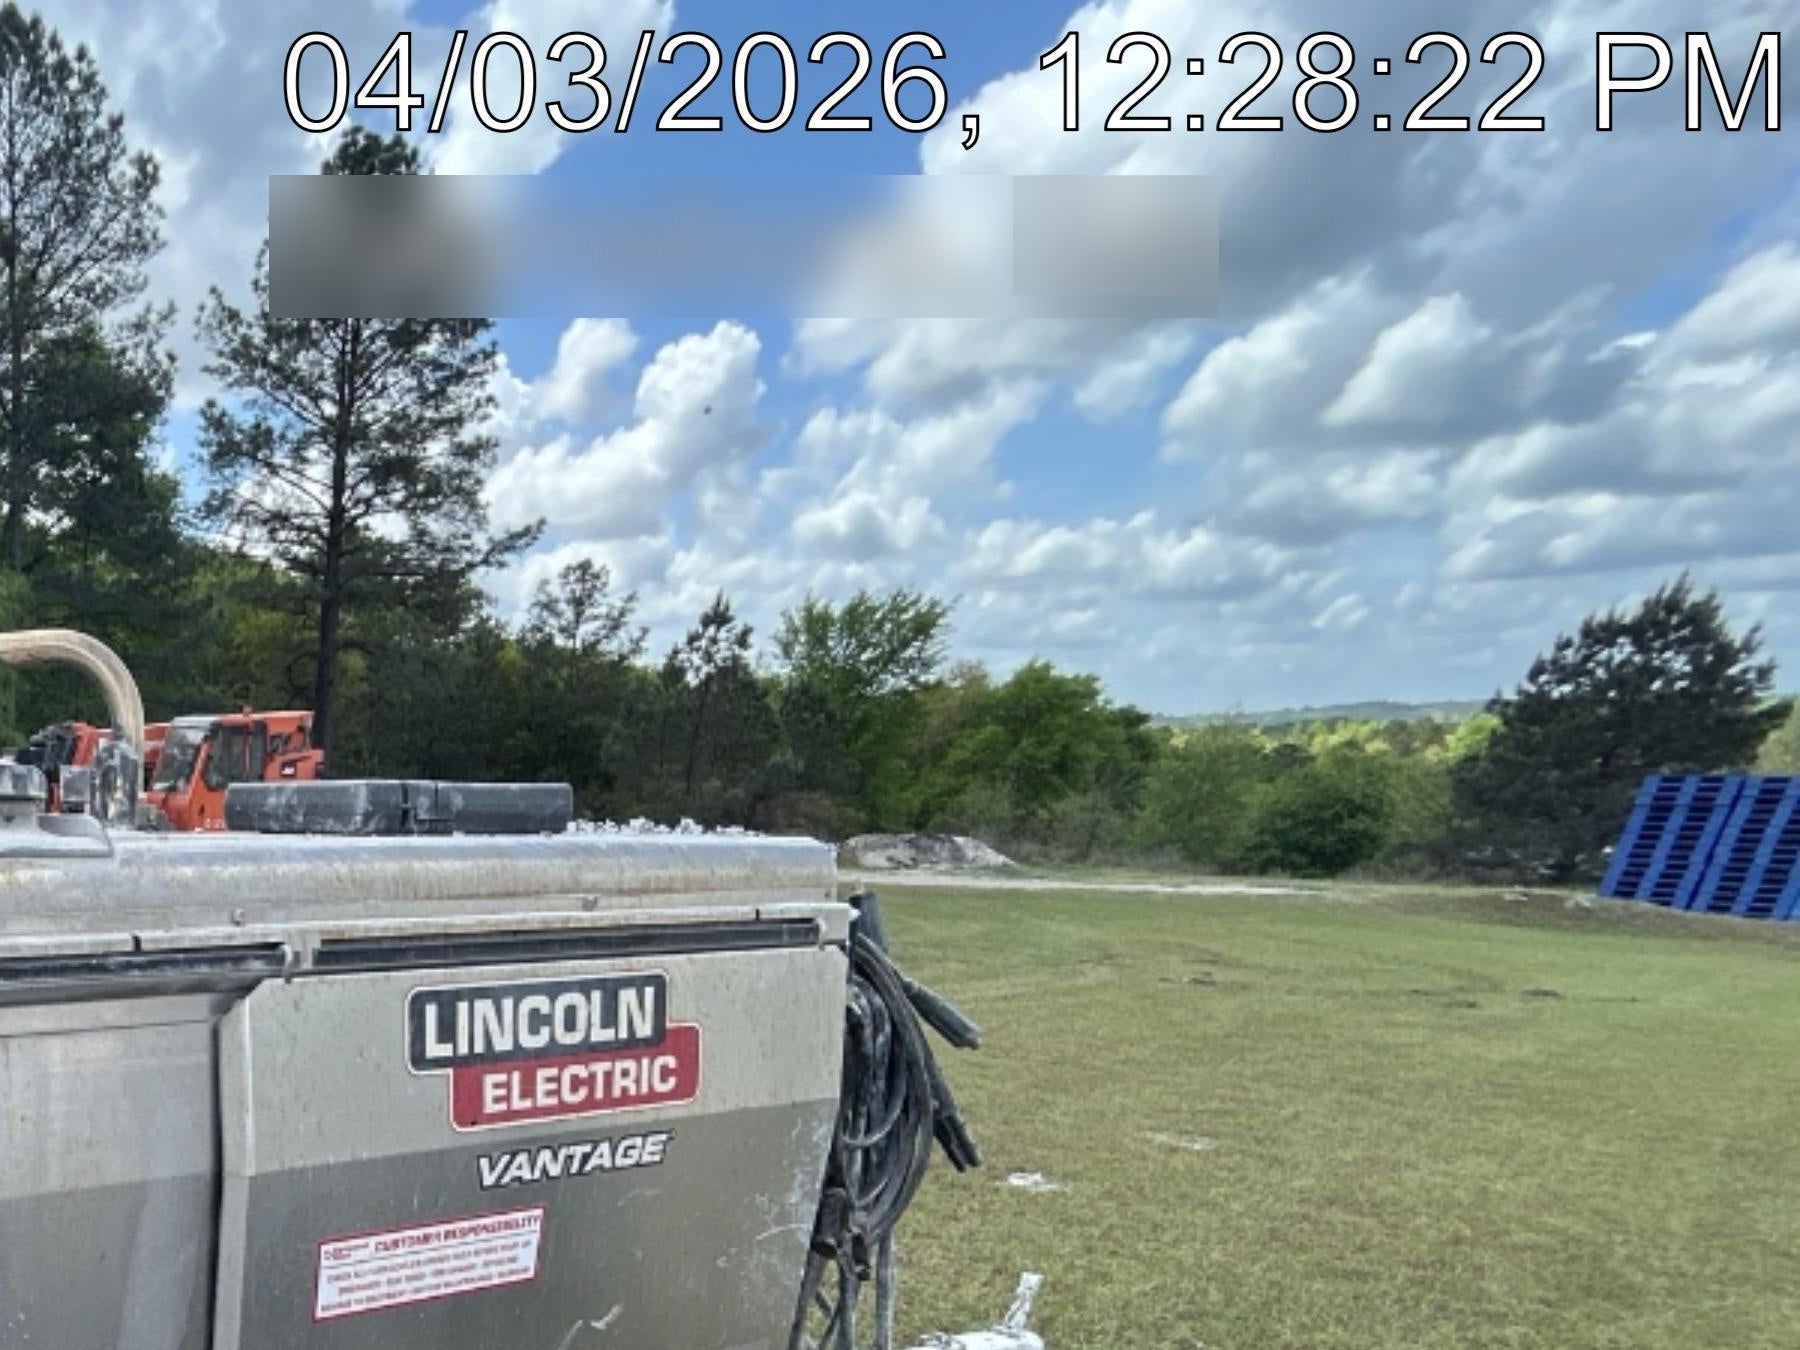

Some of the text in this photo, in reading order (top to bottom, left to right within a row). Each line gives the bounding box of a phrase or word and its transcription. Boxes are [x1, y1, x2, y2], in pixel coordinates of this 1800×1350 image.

[423, 986, 656, 1059] LINCOLN
[481, 1054, 678, 1115] ELECTRIC
[476, 1131, 672, 1190] VANTAGE
